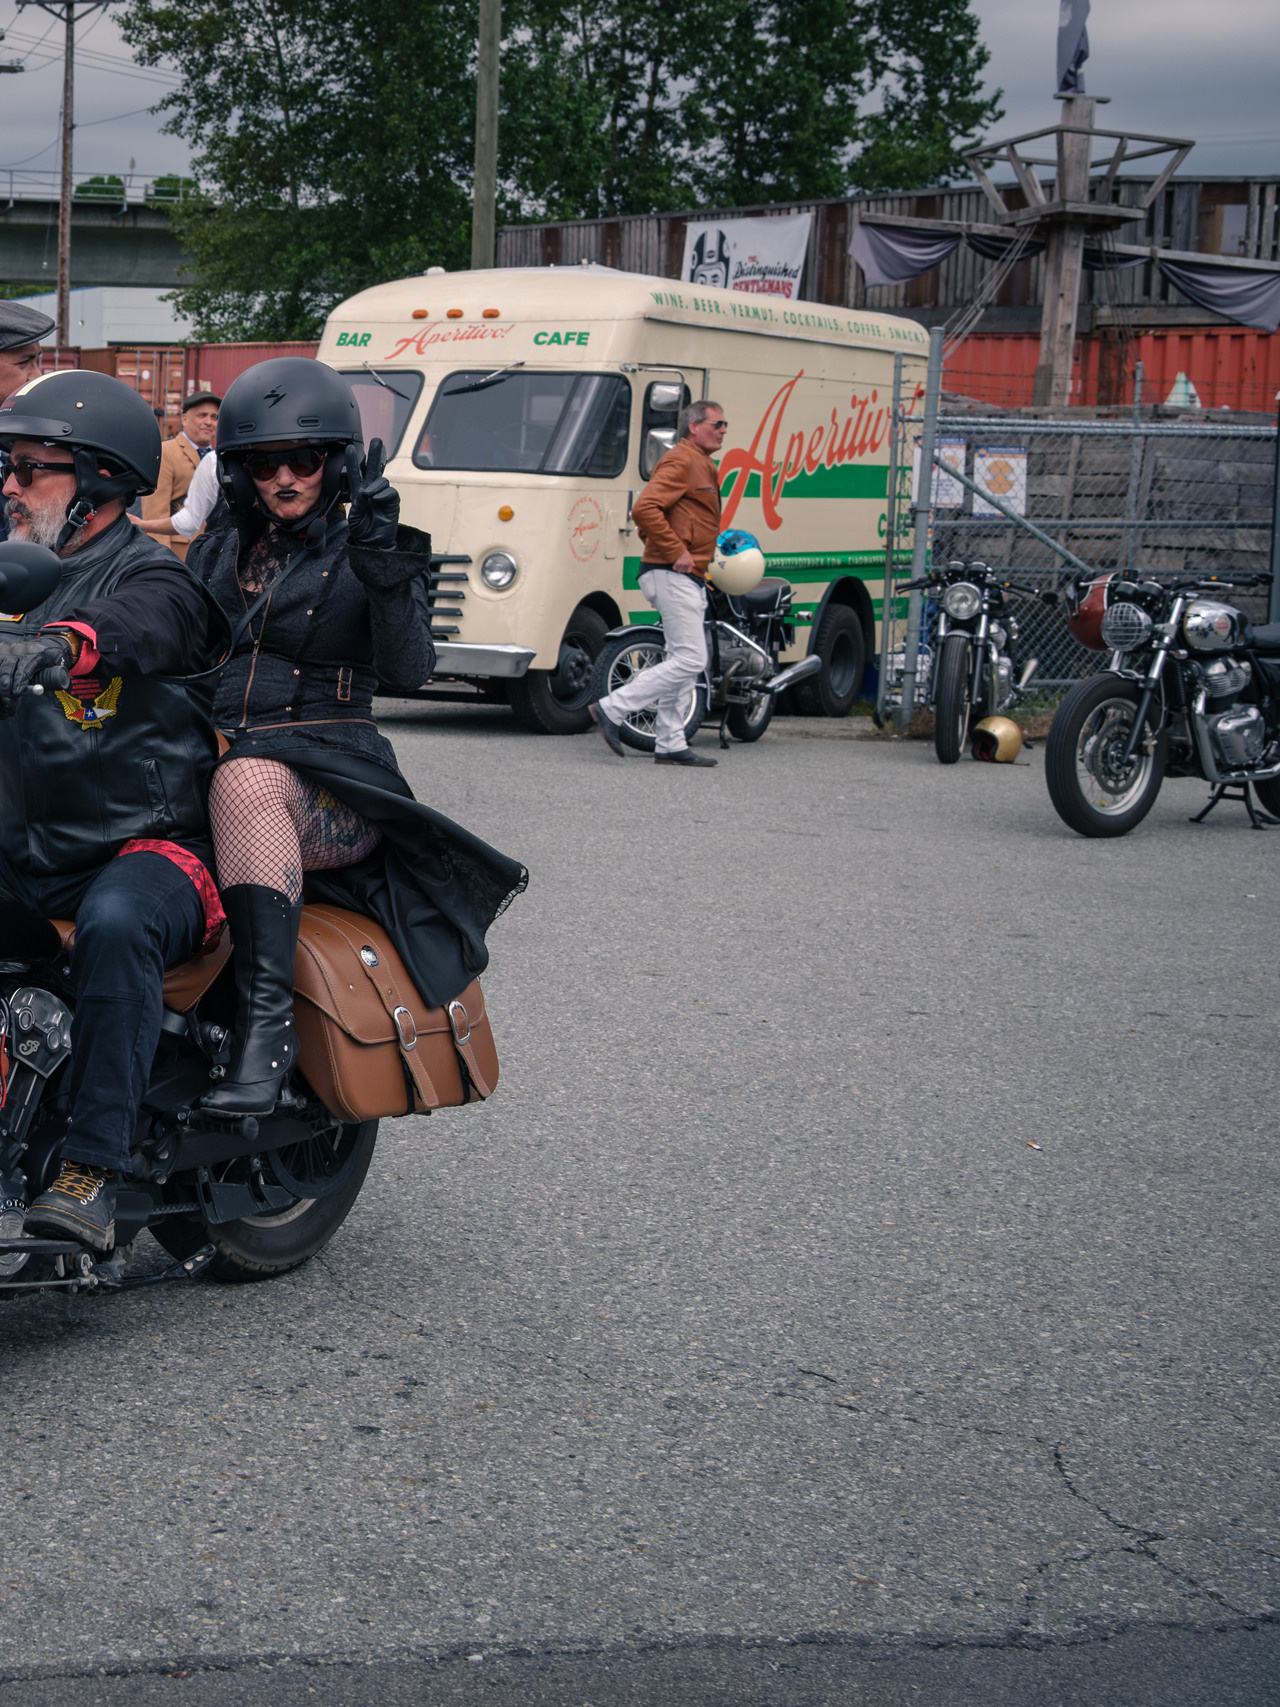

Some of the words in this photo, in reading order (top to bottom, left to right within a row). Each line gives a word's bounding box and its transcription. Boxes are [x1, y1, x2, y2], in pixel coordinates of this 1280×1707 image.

[732, 261, 801, 281] Distinguished
[336, 332, 371, 347] BAR
[384, 320, 515, 360] Aperitivo!
[533, 331, 590, 346] CAFE
